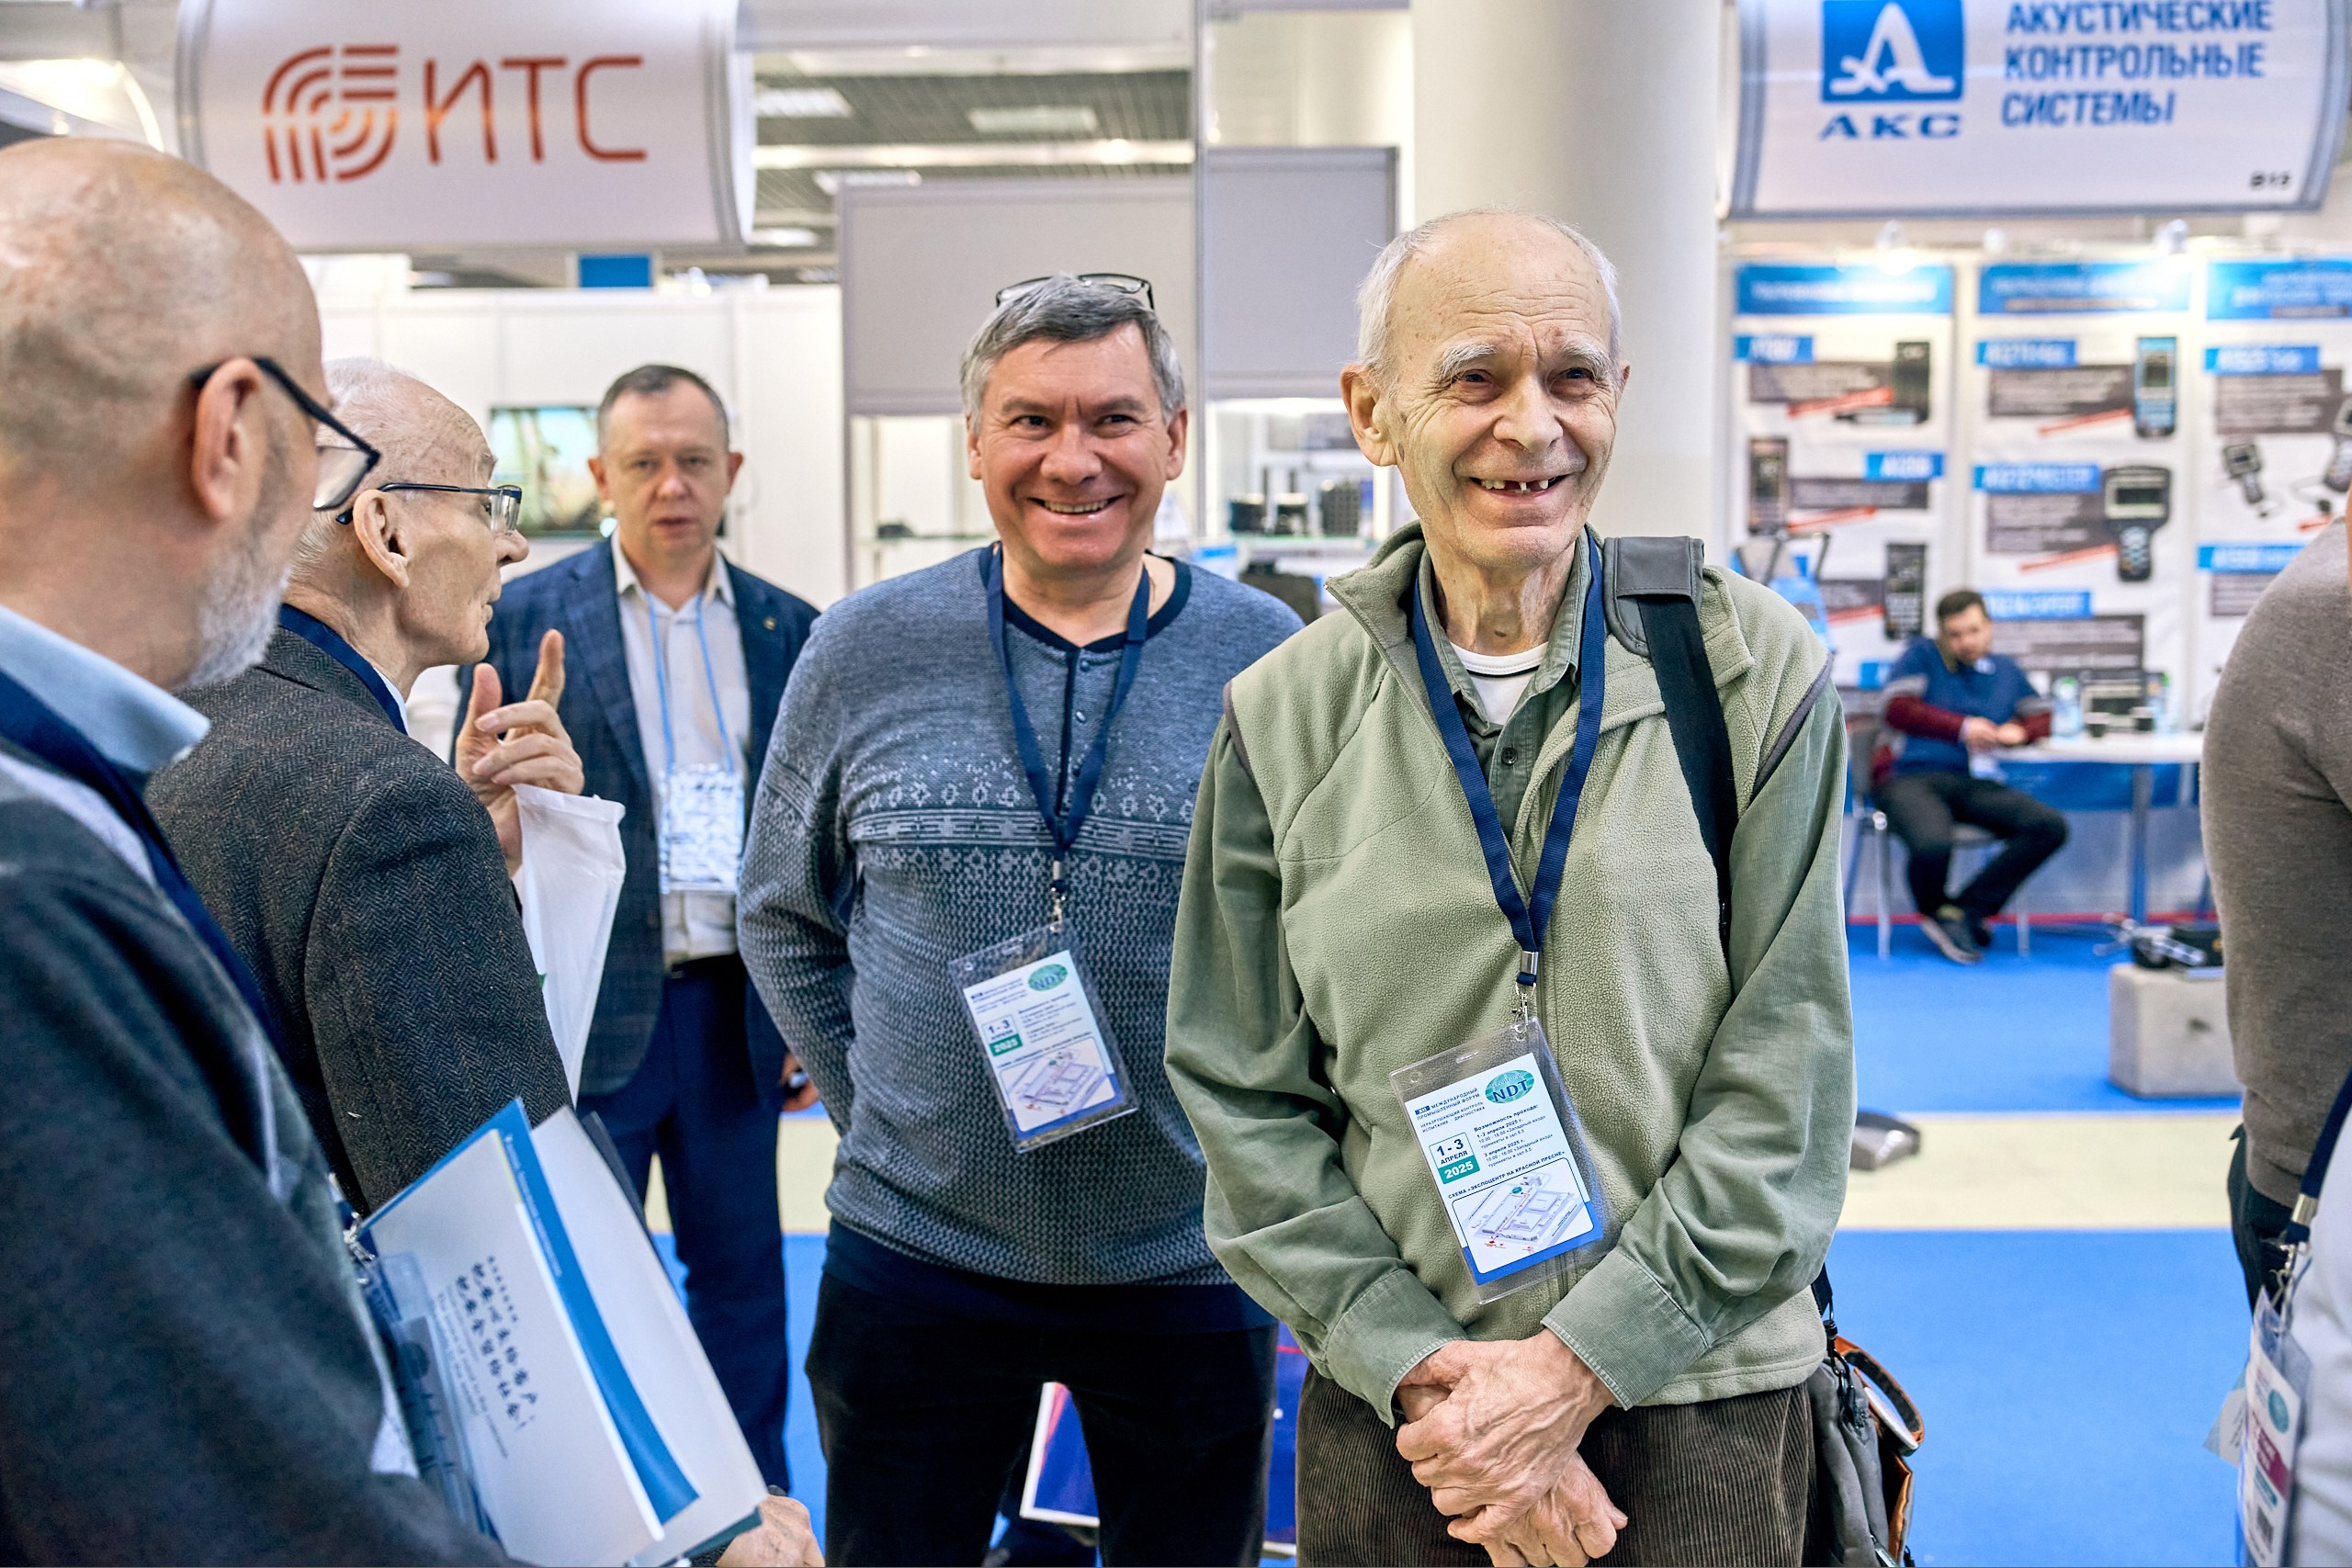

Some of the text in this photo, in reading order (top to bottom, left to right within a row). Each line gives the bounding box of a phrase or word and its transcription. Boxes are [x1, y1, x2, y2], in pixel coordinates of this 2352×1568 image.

[2007, 0, 2274, 34] АКУСТИЧЕСКИЕ
[2004, 42, 2267, 81] КОНТРОЛЬНЫЕ
[424, 56, 648, 165] ИТС
[2001, 90, 2177, 127] СИСТЕМЫ
[1819, 113, 1962, 140] АКС
[1492, 1079, 1528, 1103] NDT
[1437, 1145, 1445, 1156] 1
[1453, 1139, 1464, 1149] 3
[1441, 1150, 1468, 1165] АПРЕЛЯ
[1444, 1161, 1474, 1179] 2025
[1448, 1190, 1466, 1199] СХЕМА
